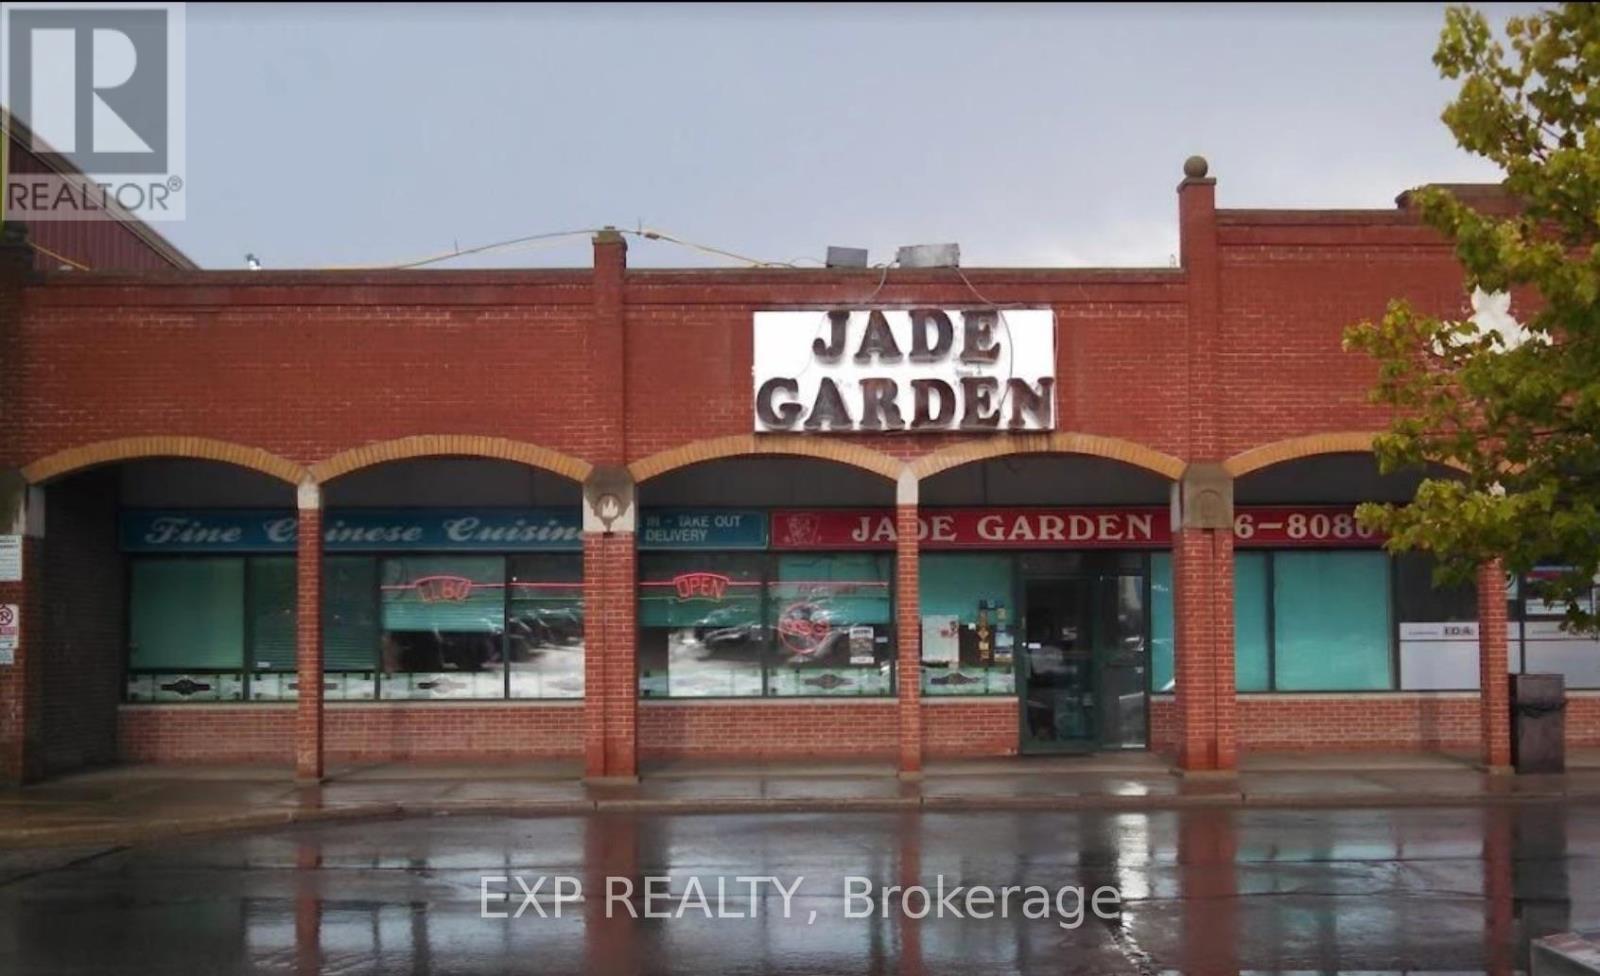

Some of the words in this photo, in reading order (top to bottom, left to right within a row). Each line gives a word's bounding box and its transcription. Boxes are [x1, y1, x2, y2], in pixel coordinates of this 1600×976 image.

[812, 310, 1001, 364] JADE
[756, 376, 1055, 431] GARDEN
[145, 516, 242, 544] Fine
[262, 516, 423, 543] Cinese
[442, 516, 583, 542] Cuisin
[645, 528, 708, 542] DELIVERY
[677, 515, 710, 528] TAKE
[714, 514, 741, 528] OUT
[976, 514, 1153, 542] GARDEN
[675, 575, 726, 599] OPEN
